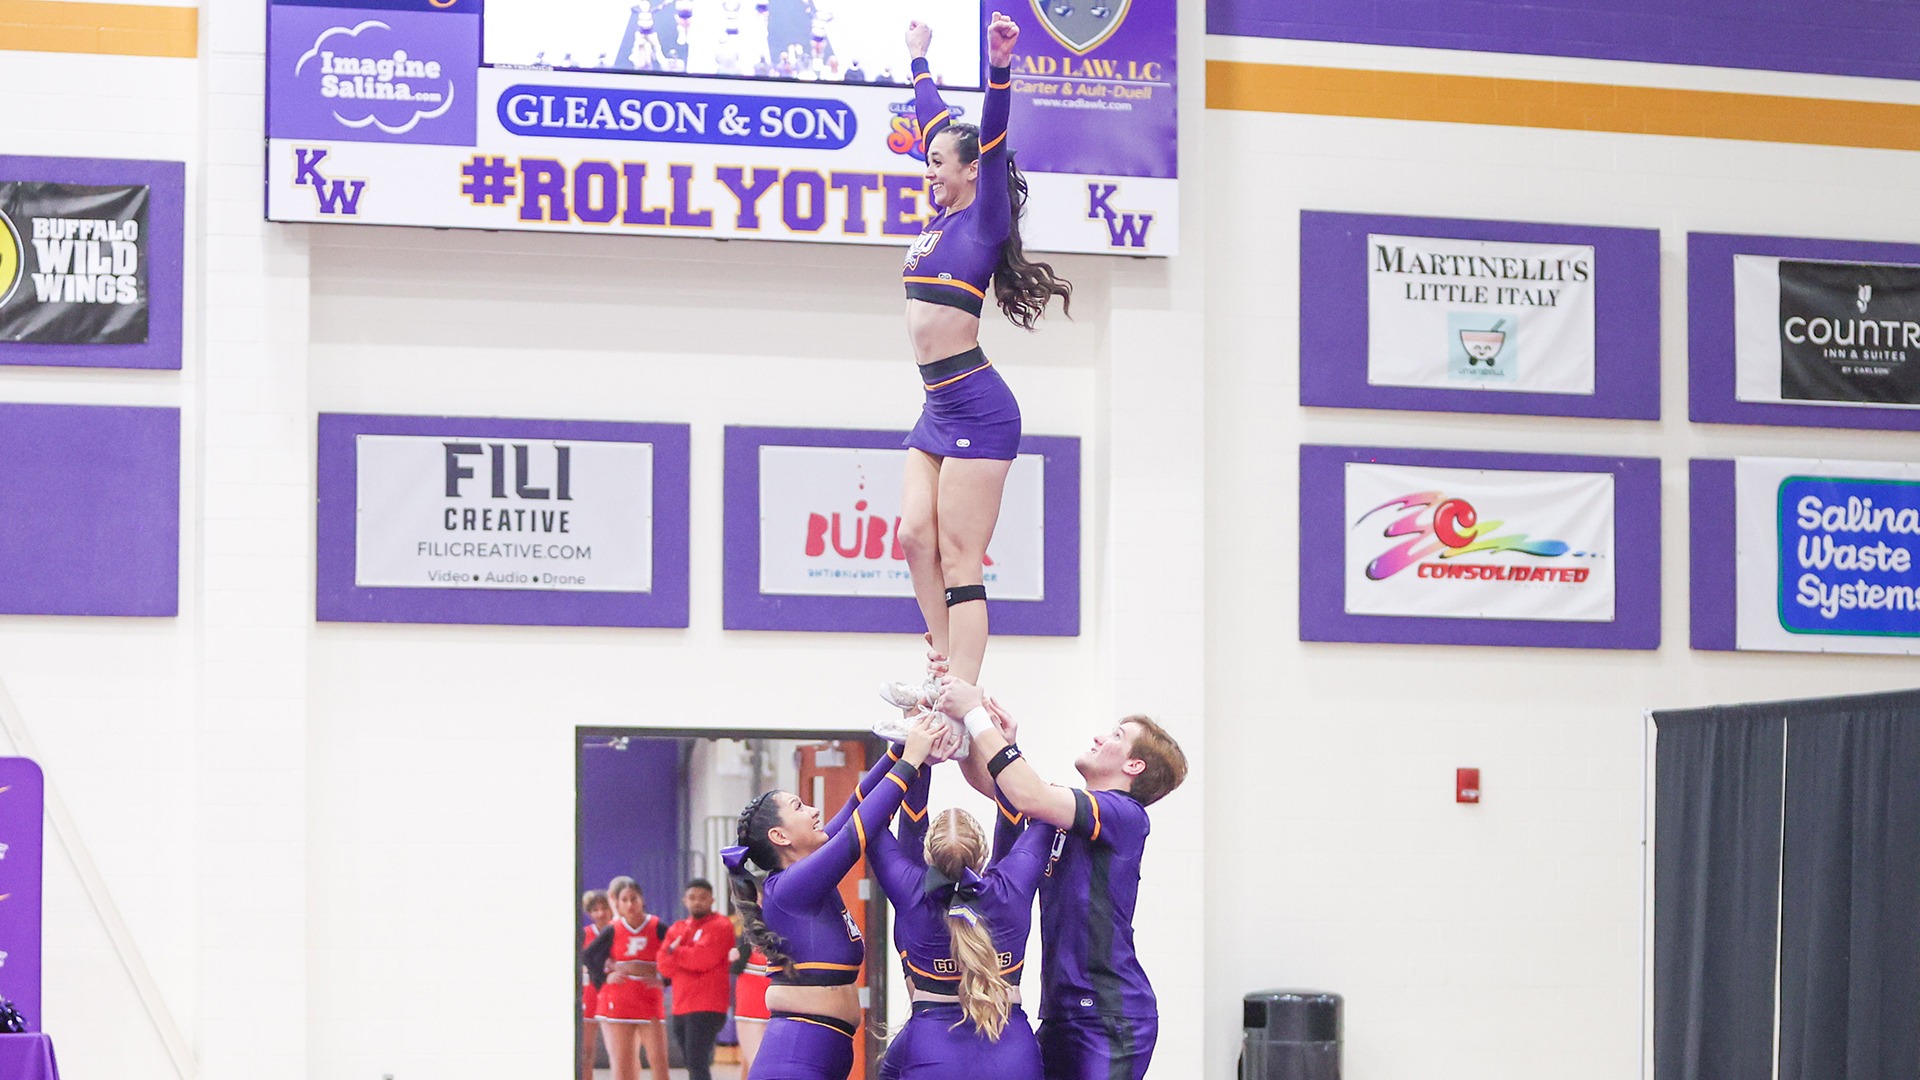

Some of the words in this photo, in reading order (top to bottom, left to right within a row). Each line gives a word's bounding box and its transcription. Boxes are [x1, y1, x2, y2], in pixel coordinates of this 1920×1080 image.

[320, 50, 441, 79] Imagine
[1010, 54, 1058, 75] CAD
[1128, 61, 1162, 81] LC
[320, 75, 442, 102] Salina.com
[1012, 80, 1059, 94] Carter
[1062, 82, 1073, 95] &
[1076, 84, 1152, 99] Ault-Duell
[506, 94, 707, 134] GLEASON
[718, 107, 751, 136] &
[759, 106, 849, 140] SON
[32, 217, 139, 242] BUFFALO
[32, 239, 138, 275] WILD
[1375, 244, 1589, 282] MARTINELLI'S
[31, 273, 138, 304] WINGS
[1405, 282, 1488, 304] LITTLE
[1497, 286, 1561, 307] ITALY
[1823, 348, 1846, 359] INN
[1850, 349, 1859, 359] &
[1862, 350, 1906, 362] SUITES
[443, 442, 574, 501] FILI
[444, 507, 570, 534] CREATIVE
[1797, 495, 1920, 534] Salina
[417, 541, 592, 560] FILICREATIVE.COM
[1797, 533, 1912, 573] Waste
[428, 570, 470, 583] Video
[485, 571, 528, 585] Audio
[542, 573, 586, 586] Drone
[1417, 563, 1590, 583] CONSOLIDATED
